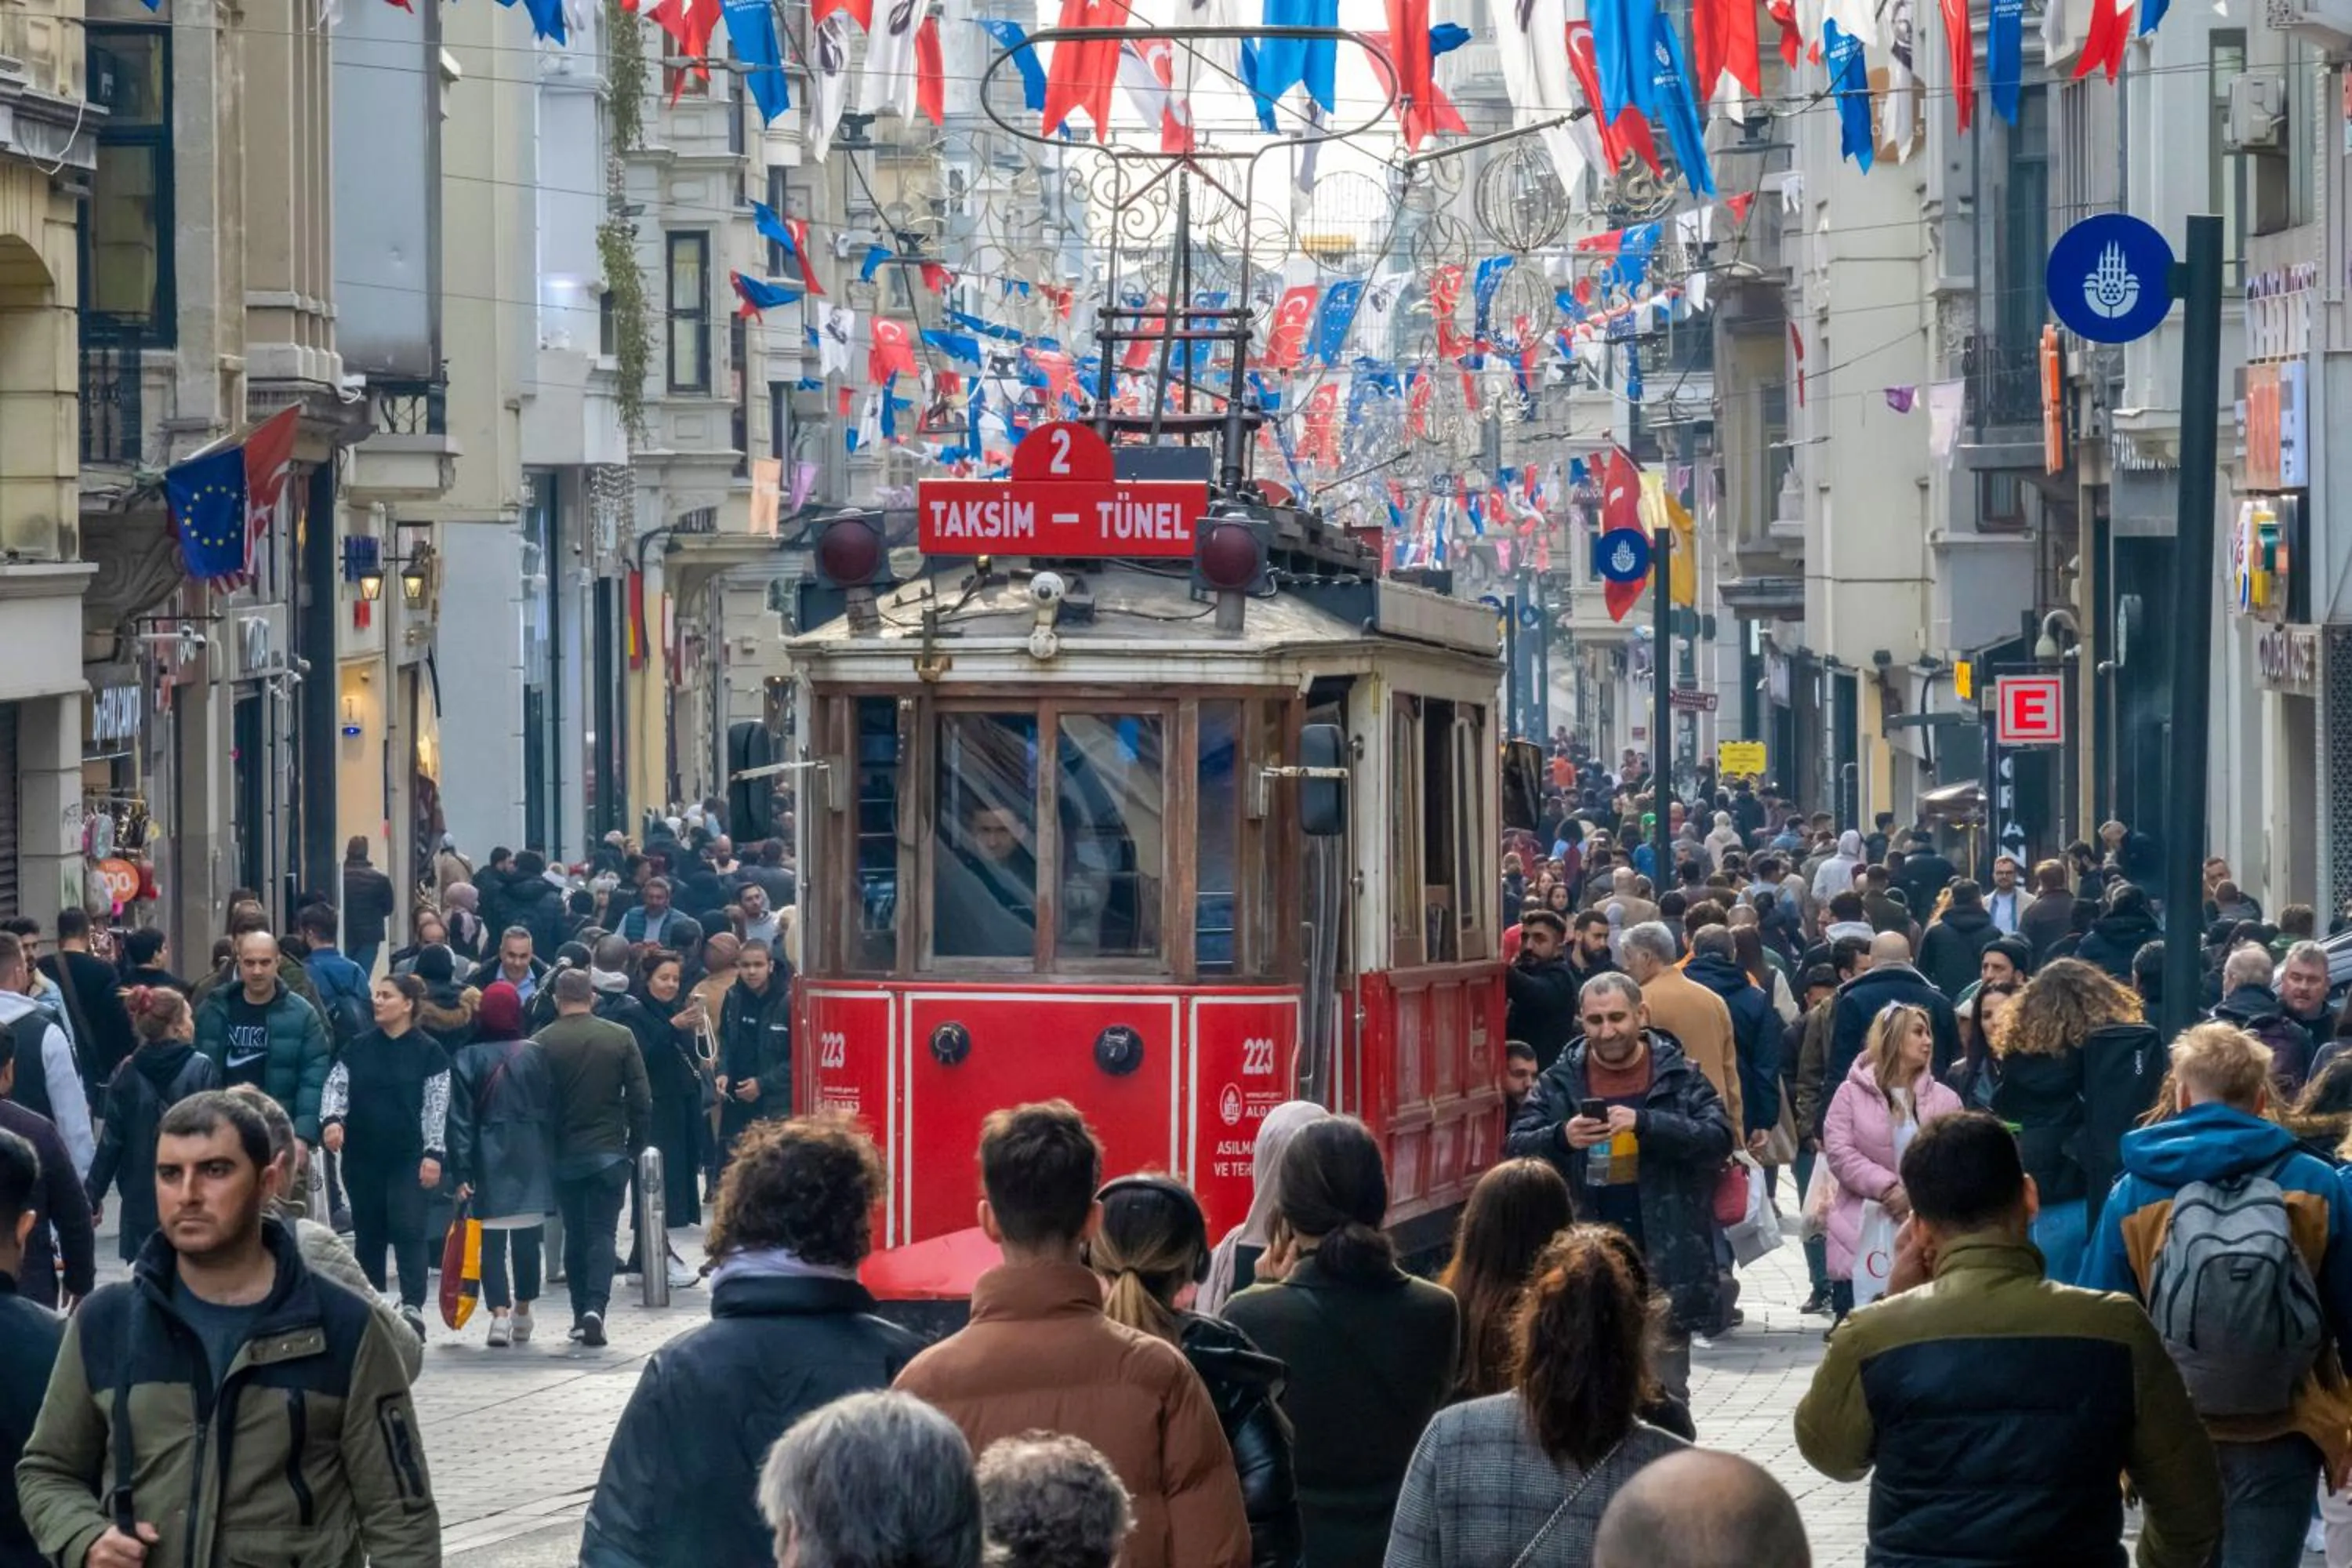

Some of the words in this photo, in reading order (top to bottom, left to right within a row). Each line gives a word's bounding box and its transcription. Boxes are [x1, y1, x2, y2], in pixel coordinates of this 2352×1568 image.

[1051, 429, 1071, 474] 2
[930, 492, 1035, 538] TAKSİM
[1096, 492, 1190, 540] TÜNEL
[2013, 690, 2047, 729] E
[821, 1032, 845, 1068] 223
[1243, 1038, 1274, 1075] 223
[1213, 1162, 1229, 1177] VE
